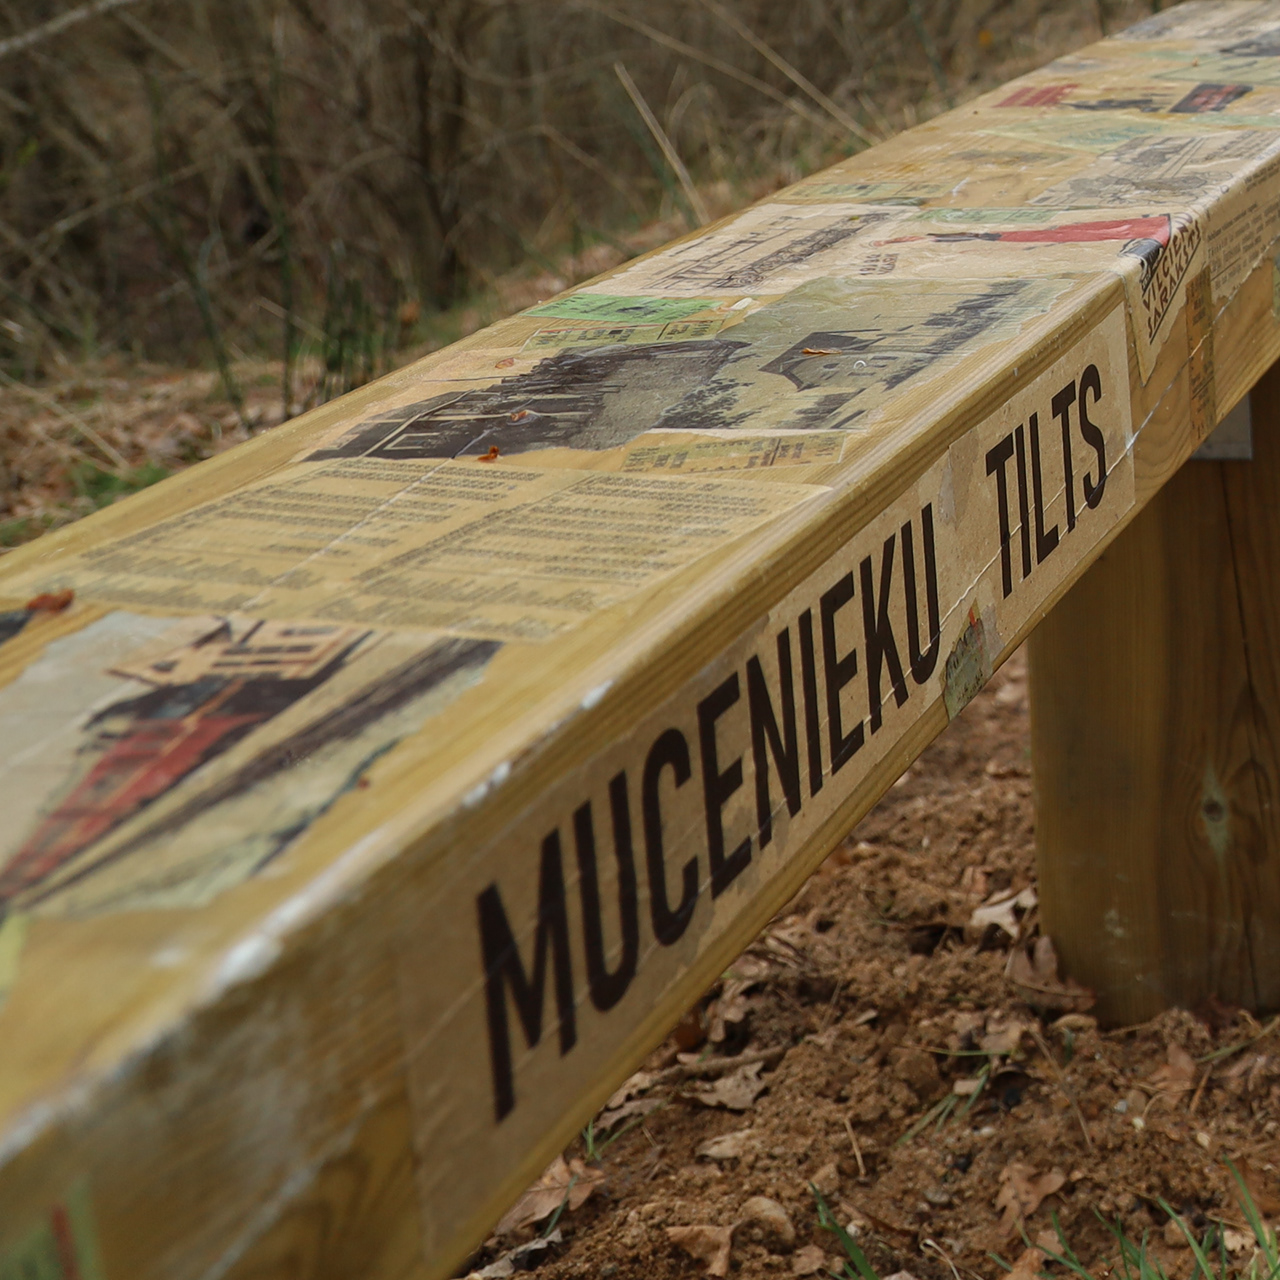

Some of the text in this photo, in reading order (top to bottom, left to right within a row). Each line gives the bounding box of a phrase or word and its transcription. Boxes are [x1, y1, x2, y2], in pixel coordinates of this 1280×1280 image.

[1147, 219, 1200, 339] SARAKSTS
[476, 363, 1107, 1124] MUCENIEKU TILTS
